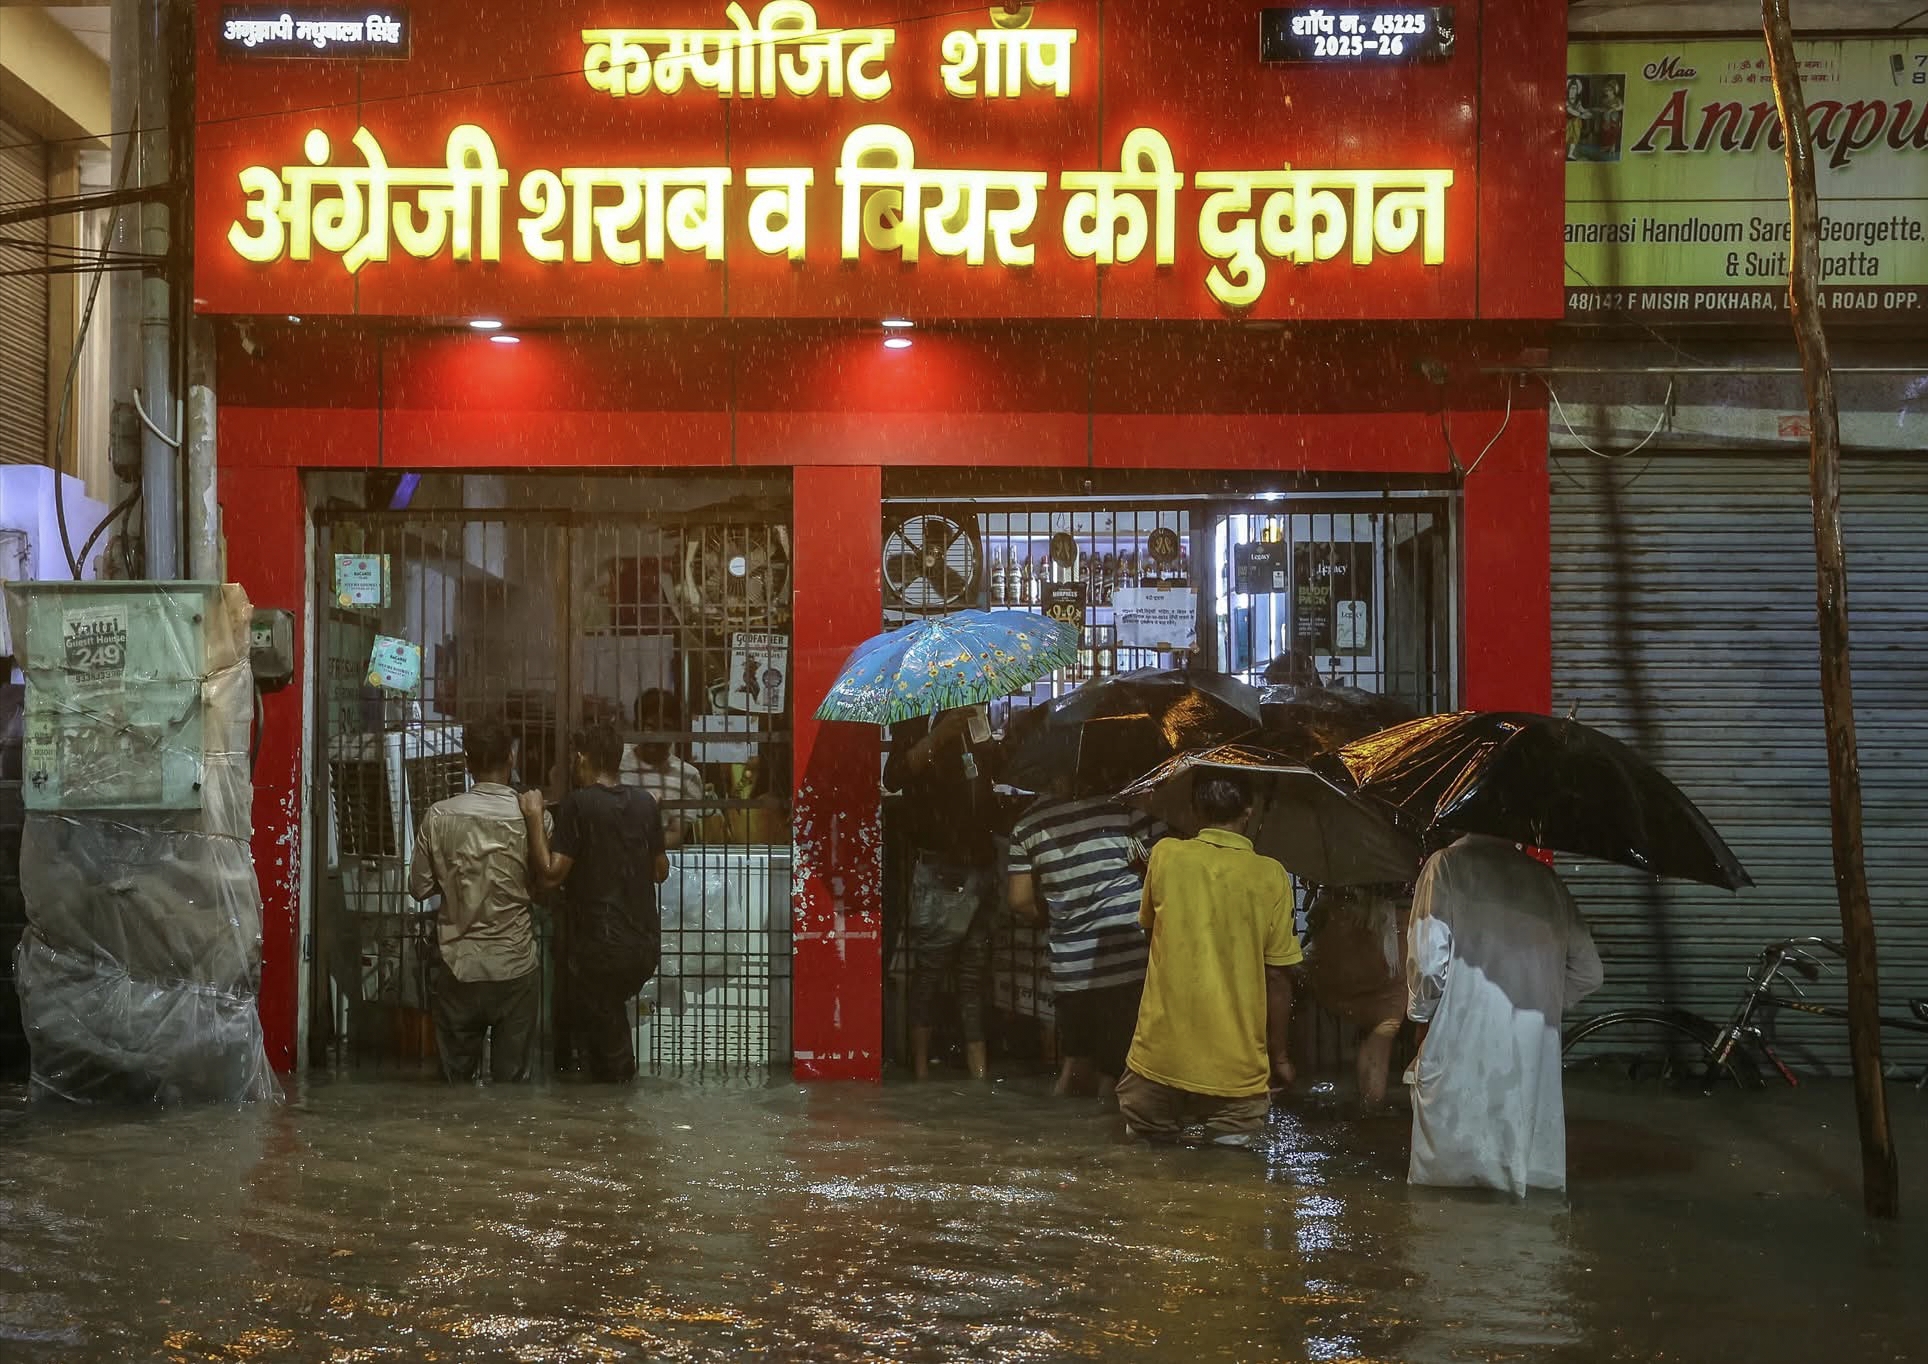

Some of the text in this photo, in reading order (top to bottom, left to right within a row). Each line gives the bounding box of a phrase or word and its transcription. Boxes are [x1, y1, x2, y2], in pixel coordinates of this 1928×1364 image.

[365, 14, 401, 44] सिंह
[1291, 10, 1336, 36] शॉप
[1372, 14, 1426, 35] 45225
[581, 0, 1078, 100] कम्पोजिट शॉप
[1314, 35, 1404, 57] 2025-26
[1643, 56, 1697, 81] Maa
[227, 124, 1454, 306] अंग्रेजी शराब व बियर की दुकान
[1643, 218, 1742, 242] Handloom
[1726, 252, 1739, 276] &
[1628, 293, 1637, 310] F
[1641, 293, 1690, 310] MISIR
[1695, 292, 1777, 311] POKHARA,
[1832, 292, 1878, 309] ROAD
[1884, 292, 1921, 309] OPP.
[76, 644, 120, 667] 249
